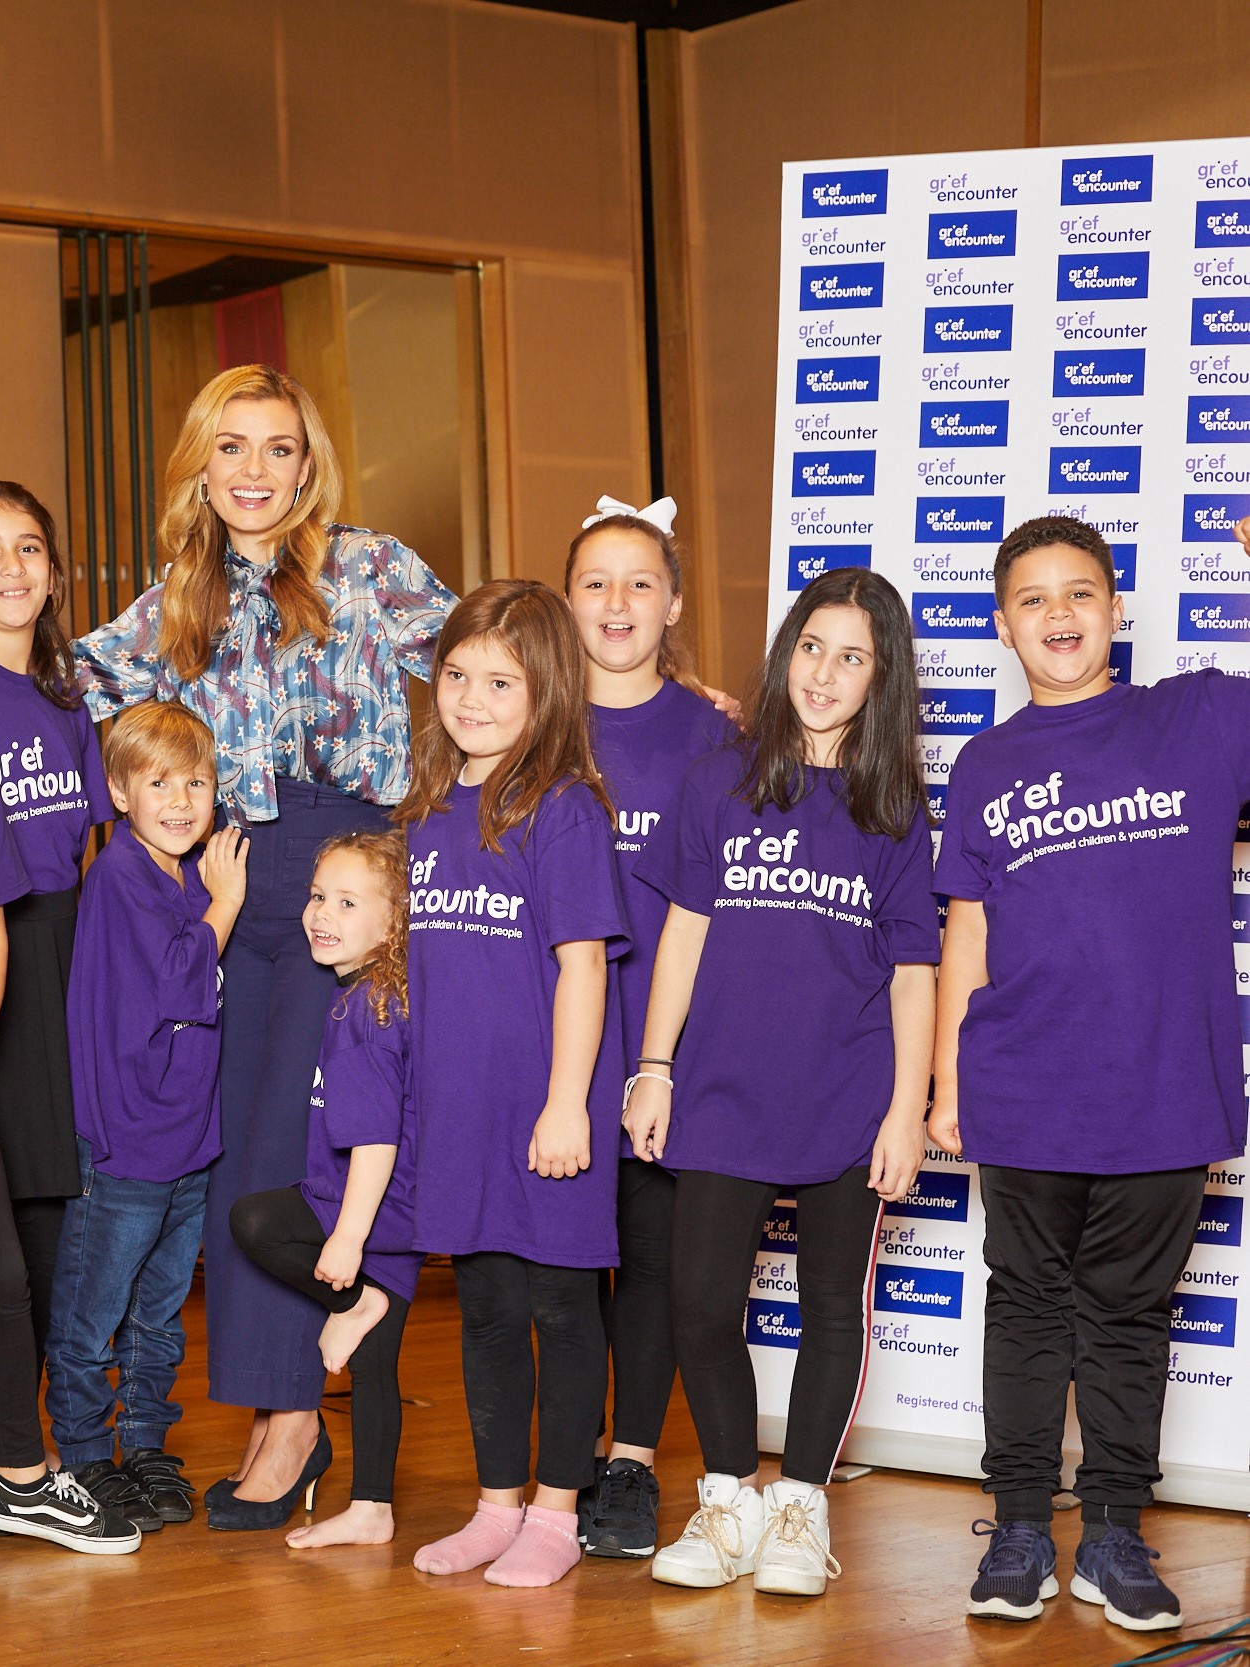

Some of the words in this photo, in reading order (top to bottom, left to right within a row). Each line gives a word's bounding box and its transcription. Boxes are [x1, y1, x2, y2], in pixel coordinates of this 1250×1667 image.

[930, 174, 968, 193] gref
[1073, 170, 1103, 185] gref
[813, 183, 842, 200] gref
[1079, 179, 1141, 192] encounter
[819, 191, 877, 206] encounter
[937, 186, 1018, 201] encounter
[939, 224, 969, 239] gref
[1060, 215, 1100, 235] gref
[802, 228, 840, 246] gref
[945, 233, 1005, 246] encounter
[1068, 227, 1151, 243] encounter
[809, 240, 886, 255] encounter
[926, 268, 965, 287] gref
[1069, 266, 1100, 281] gref
[810, 276, 839, 292] gref
[933, 281, 1014, 296] encounter
[1075, 275, 1137, 288] encounter
[816, 285, 873, 299] encounter
[799, 320, 836, 339] gref
[806, 333, 882, 348] encounter
[922, 363, 961, 382] gref
[1065, 362, 1096, 377] gref
[807, 370, 835, 385] gref
[929, 376, 1010, 390] encounter
[1071, 372, 1133, 385] encounter
[812, 380, 869, 392] encounter
[795, 414, 831, 432] gref
[931, 414, 961, 429] gref
[802, 427, 878, 441] encounter
[937, 424, 997, 436] encounter
[1061, 459, 1092, 474] gref
[1067, 470, 1129, 481] encounter
[791, 507, 827, 525] gref
[927, 509, 957, 524] gref
[798, 520, 873, 534] encounter
[933, 519, 993, 531] encounter
[77, 798, 83, 808] &
[983, 771, 1063, 837] gref
[1006, 786, 1187, 849] encounter
[1033, 839, 1077, 858] bereaved
[1078, 833, 1117, 850] children
[1118, 831, 1127, 842] &
[1127, 827, 1157, 843] young
[1158, 822, 1190, 838] people
[753, 897, 795, 910] bereaved
[797, 899, 826, 916] children
[827, 907, 834, 918] &
[835, 910, 862, 927] young
[428, 919, 455, 931] children
[456, 920, 463, 930] &
[490, 927, 523, 939] people
[877, 1226, 916, 1244] gref
[884, 1242, 965, 1261] encounter
[886, 1279, 916, 1293] gref
[891, 1290, 951, 1305] encounter
[872, 1323, 910, 1340] gref
[879, 1338, 959, 1357] encounter
[896, 1393, 959, 1410] Registered
